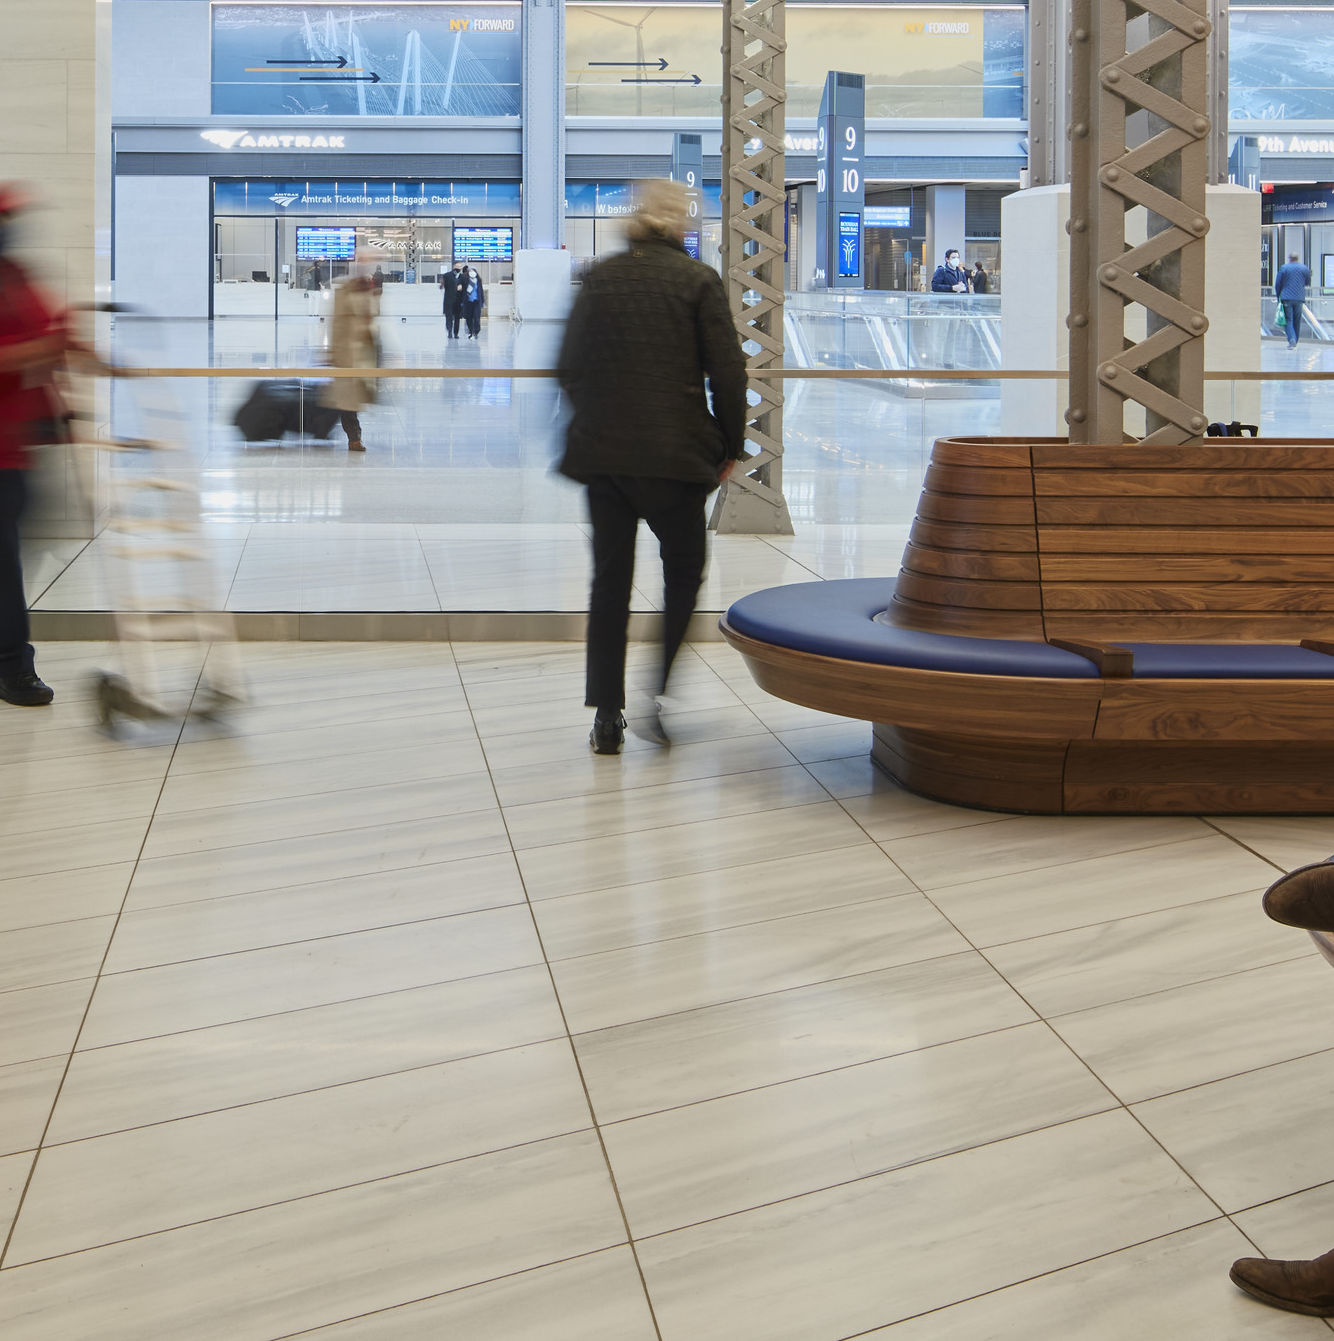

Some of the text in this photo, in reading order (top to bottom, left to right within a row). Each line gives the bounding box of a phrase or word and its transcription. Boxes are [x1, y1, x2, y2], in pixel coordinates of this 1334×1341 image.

[450, 19, 514, 30] NY FORWARD
[905, 22, 969, 33] NY FORWARD
[240, 136, 345, 148] AMTRAK
[819, 126, 825, 150] 9
[845, 126, 856, 150] 9
[1258, 136, 1284, 152] 9th
[687, 171, 695, 188] 9
[817, 168, 826, 193] 10
[842, 168, 859, 193] 10
[301, 195, 469, 205] Amtrak Ticketing and Baggage Check-in
